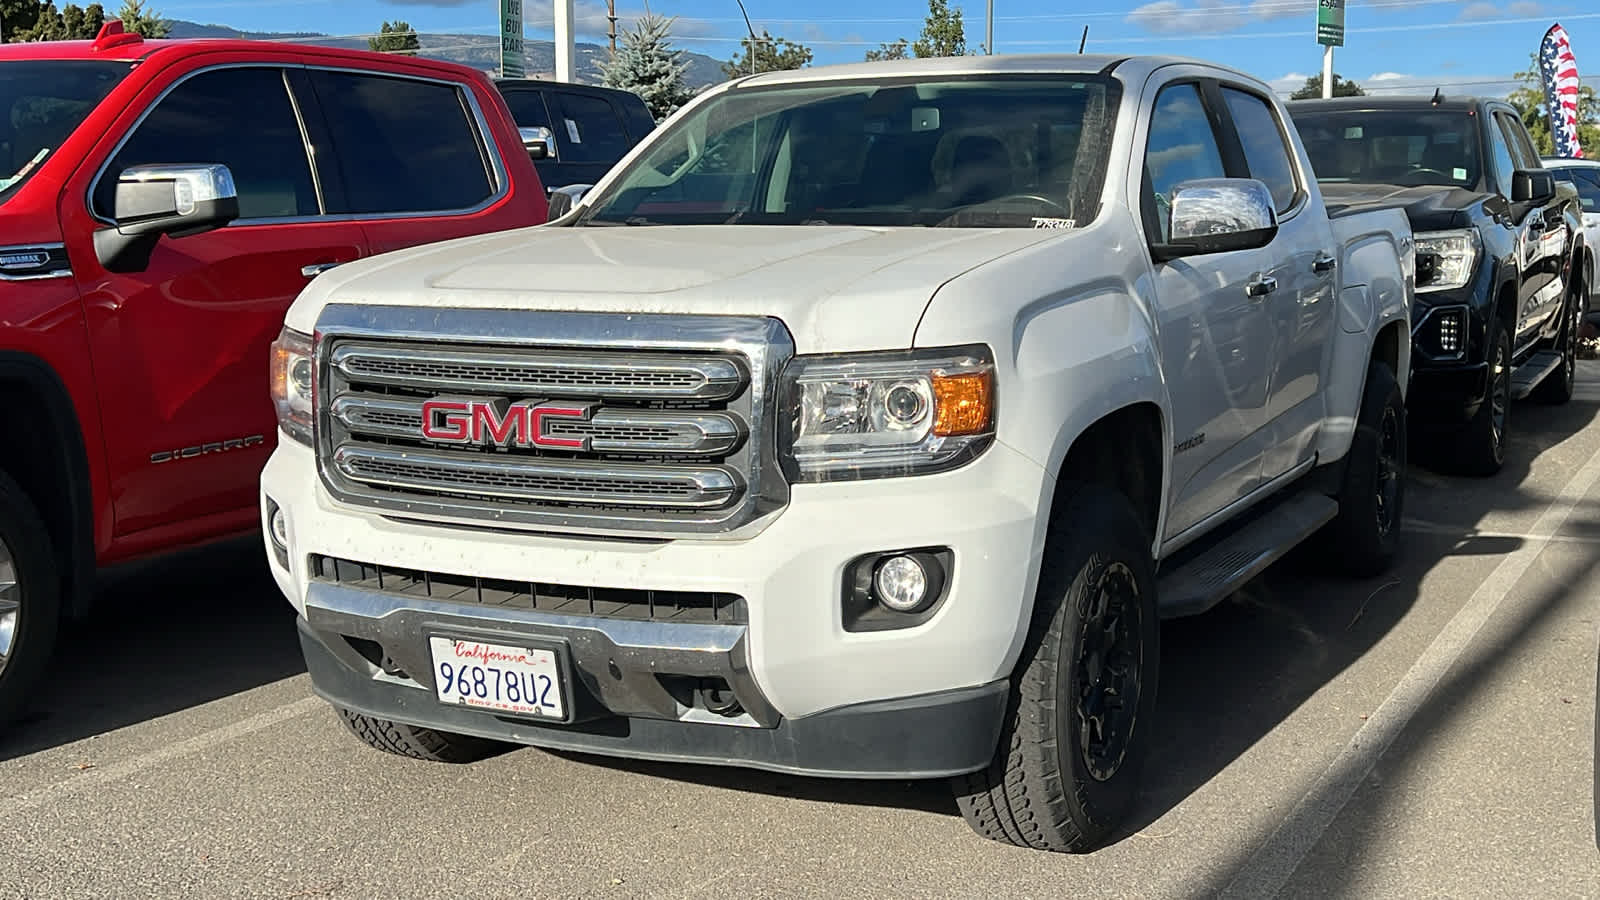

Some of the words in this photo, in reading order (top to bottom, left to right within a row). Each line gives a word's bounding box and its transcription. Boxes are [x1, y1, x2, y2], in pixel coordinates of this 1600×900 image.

[503, 37, 525, 53] CARS
[421, 400, 592, 451] GMC
[150, 434, 264, 464] SIERRA
[455, 641, 538, 666] California
[440, 662, 556, 708] 96878U2
[467, 698, 534, 713] dmv.ca.gov
